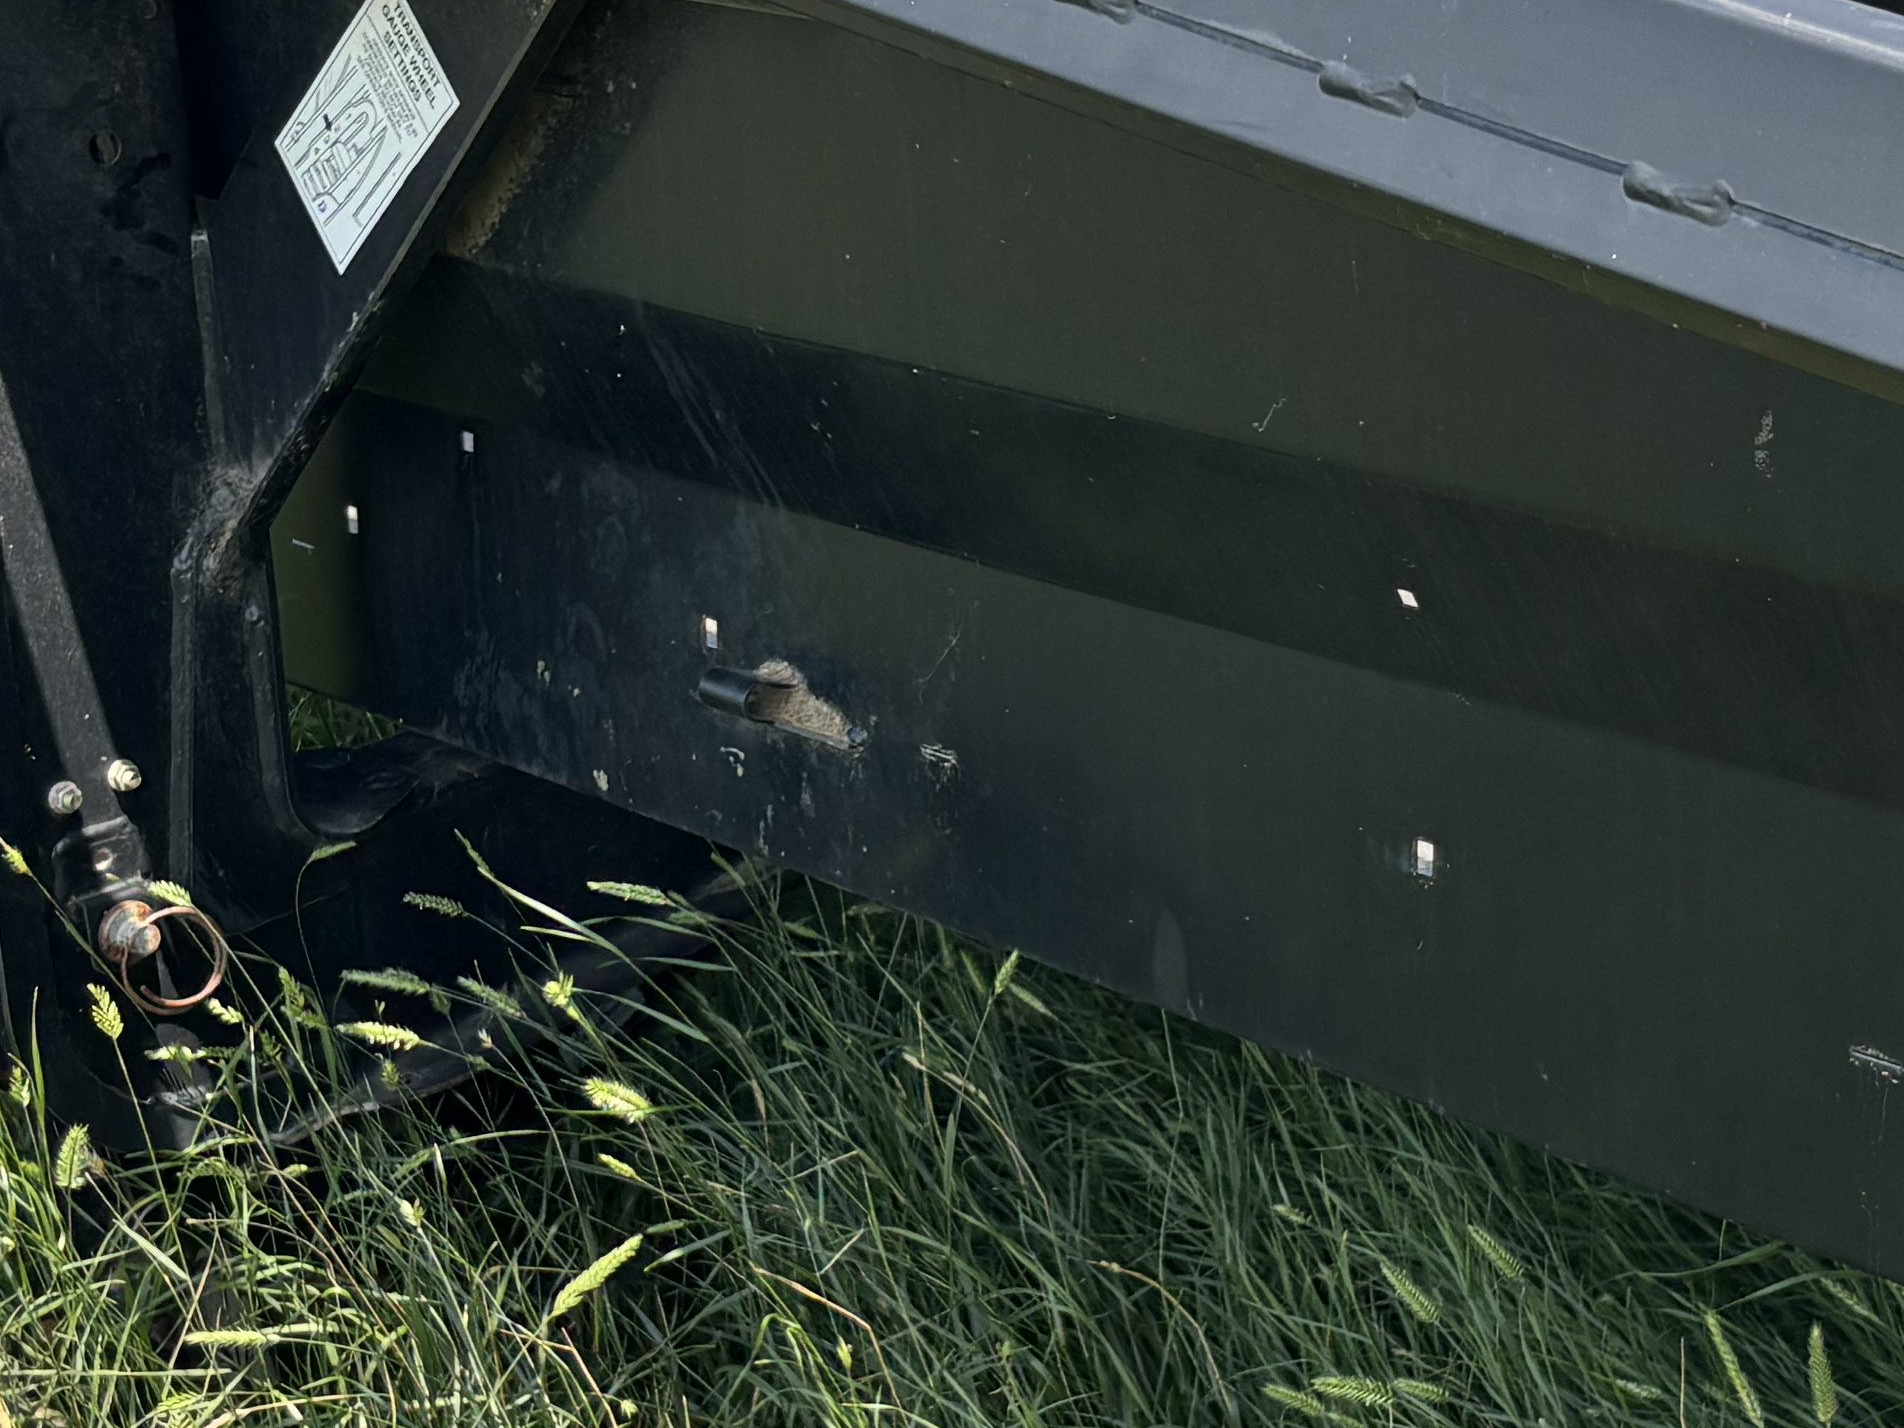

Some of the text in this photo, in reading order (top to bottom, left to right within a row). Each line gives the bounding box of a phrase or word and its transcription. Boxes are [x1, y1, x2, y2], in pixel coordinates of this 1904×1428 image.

[382, 4, 412, 58] GAUGE
[409, 54, 436, 110] WHEEL
[383, 31, 422, 103] SETTINGS
[394, 1, 441, 88] TRANSPORT
